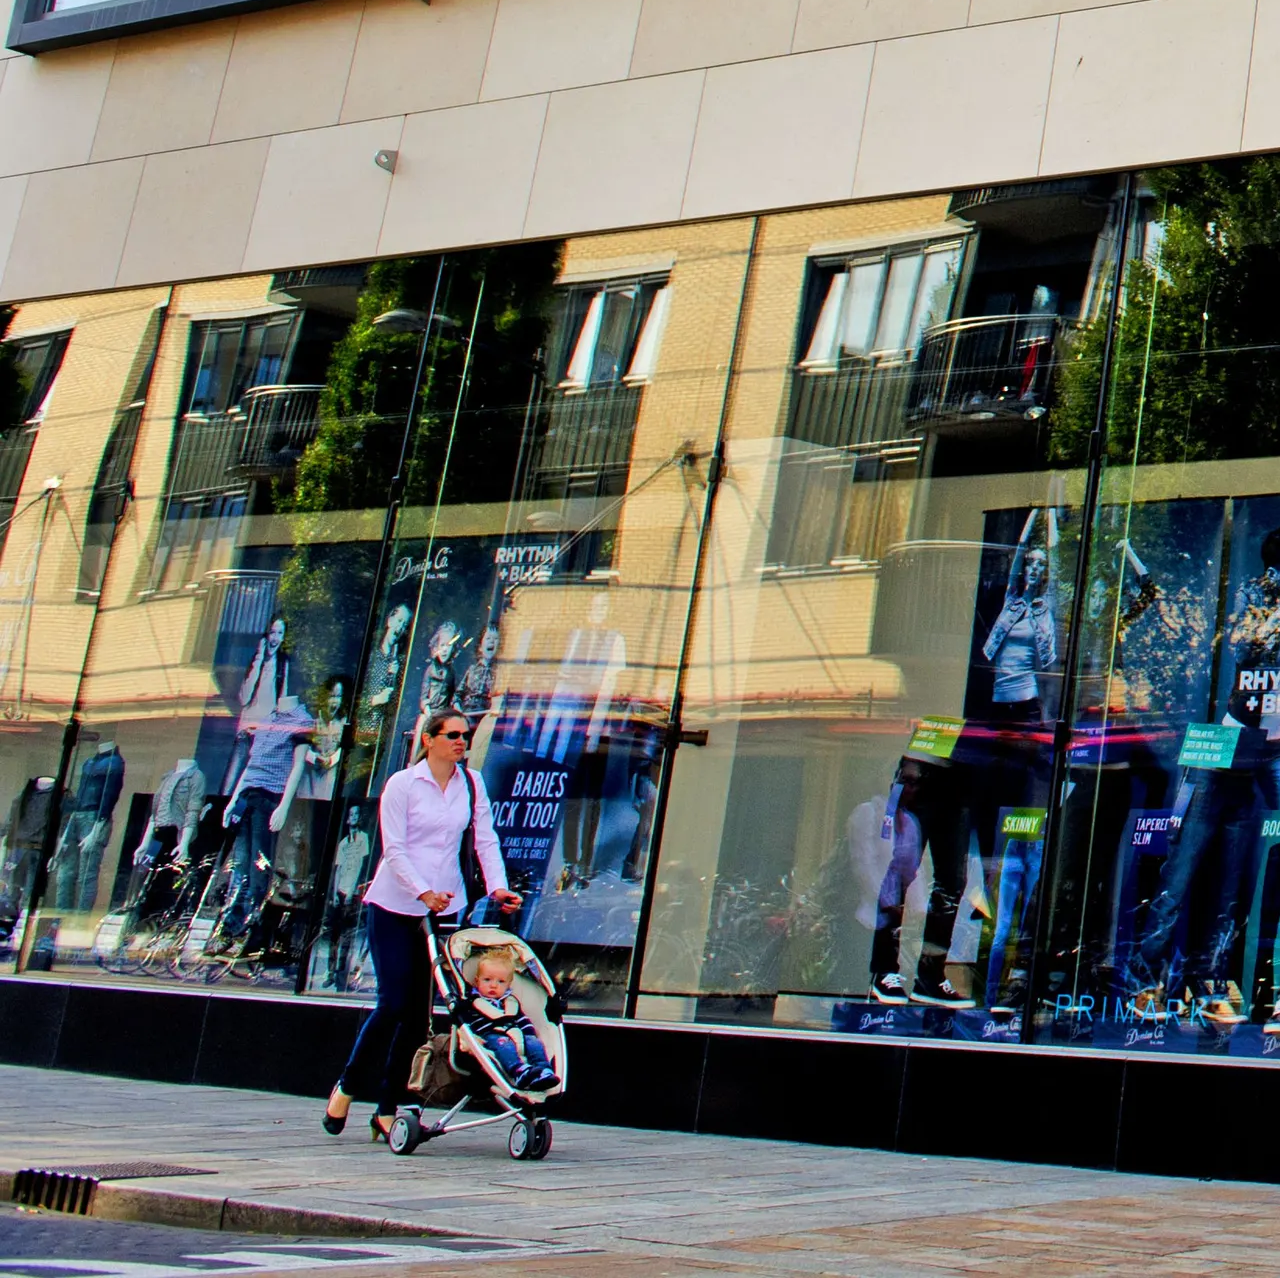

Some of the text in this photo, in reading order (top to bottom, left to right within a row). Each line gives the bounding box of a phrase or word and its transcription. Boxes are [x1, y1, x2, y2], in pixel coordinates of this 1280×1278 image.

[494, 545, 560, 563] RHYTHM
[511, 771, 568, 798] BABIES
[491, 801, 560, 828] OCK TOO!
[1002, 815, 1039, 833] SKINNY
[1132, 832, 1152, 845] SLIM
[1055, 993, 1208, 1027] PRIMARK
